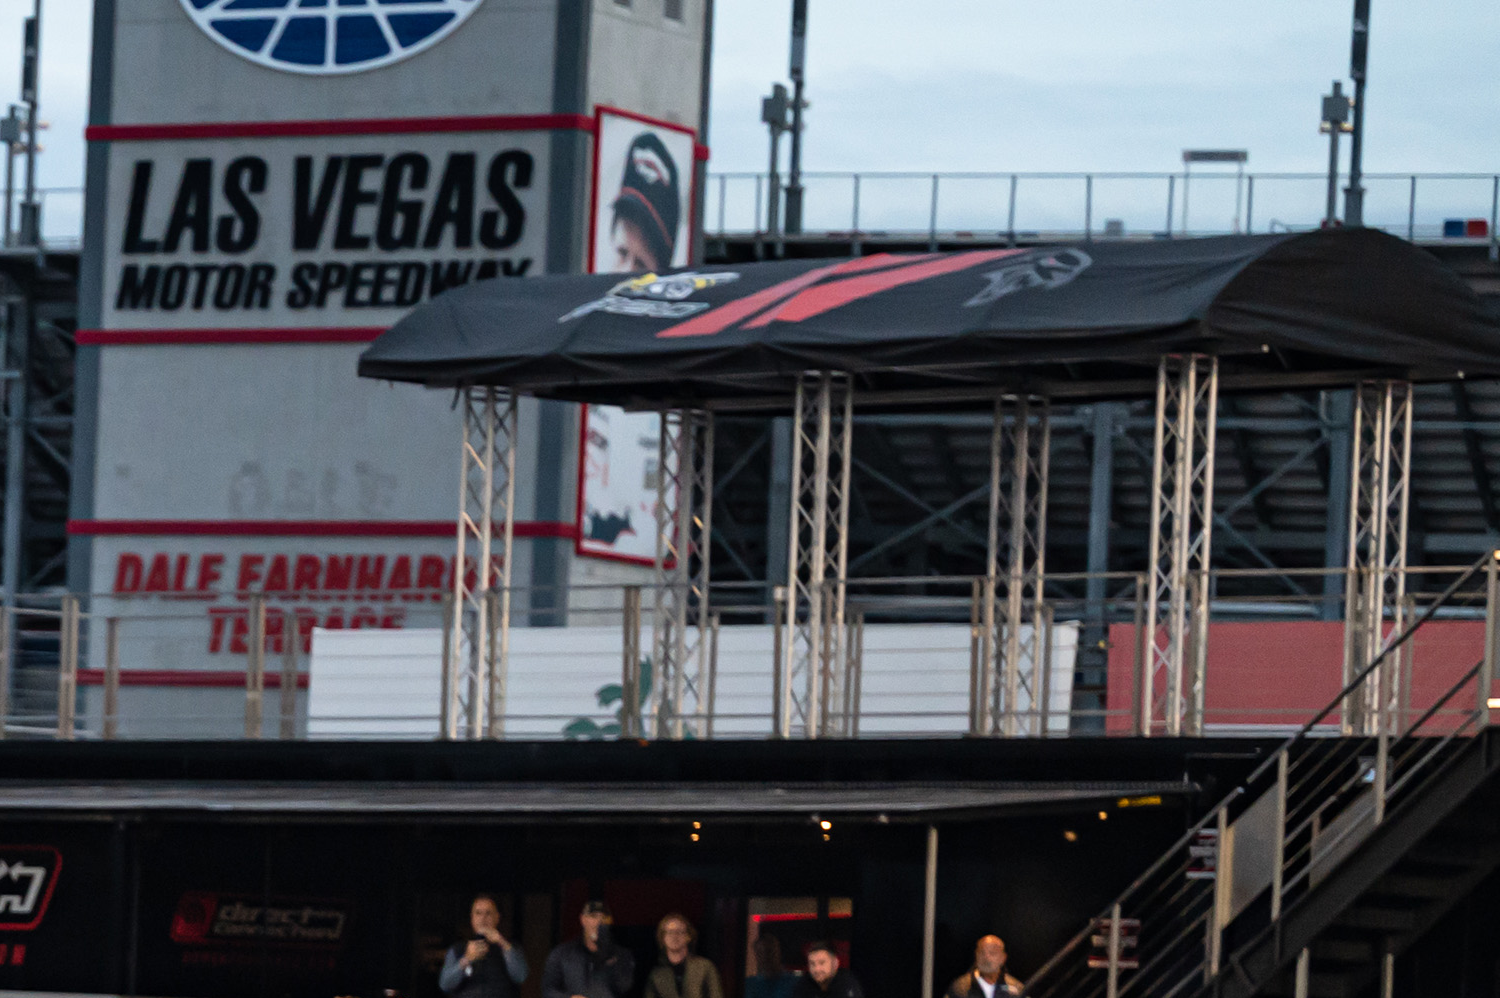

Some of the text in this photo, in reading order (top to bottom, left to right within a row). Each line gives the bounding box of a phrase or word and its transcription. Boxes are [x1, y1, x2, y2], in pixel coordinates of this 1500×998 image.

[122, 149, 534, 255] LAS VEGAS
[114, 262, 277, 310] MOTOR
[113, 553, 225, 600] DALE
